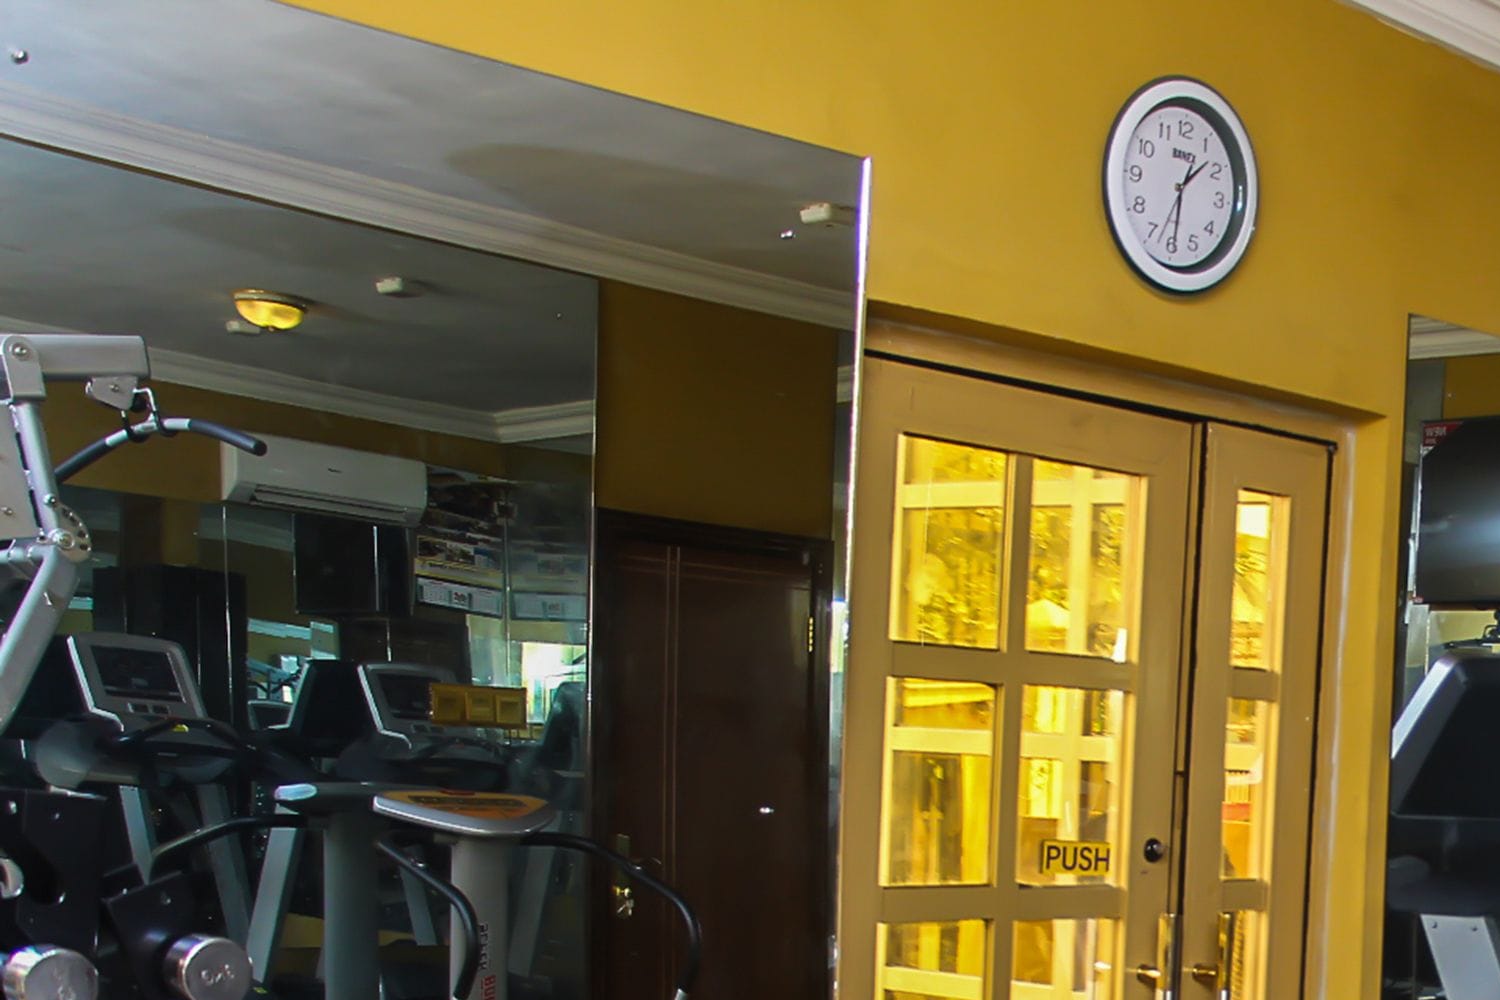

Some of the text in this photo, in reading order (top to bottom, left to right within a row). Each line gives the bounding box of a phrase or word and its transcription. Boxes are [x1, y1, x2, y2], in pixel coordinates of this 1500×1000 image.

[1158, 121, 1171, 141] 11
[1178, 119, 1194, 140] 12
[1138, 138, 1155, 158] 10
[1203, 137, 1209, 153] 1
[1129, 164, 1143, 182] 9
[1210, 163, 1222, 180] 2
[1133, 196, 1145, 214] 8
[1213, 191, 1225, 209] 3
[1148, 222, 1159, 239] 7
[1204, 220, 1215, 237] 4
[1166, 236, 1178, 254] 6
[1188, 234, 1199, 252] 5
[1046, 845, 1110, 872] PUSH
